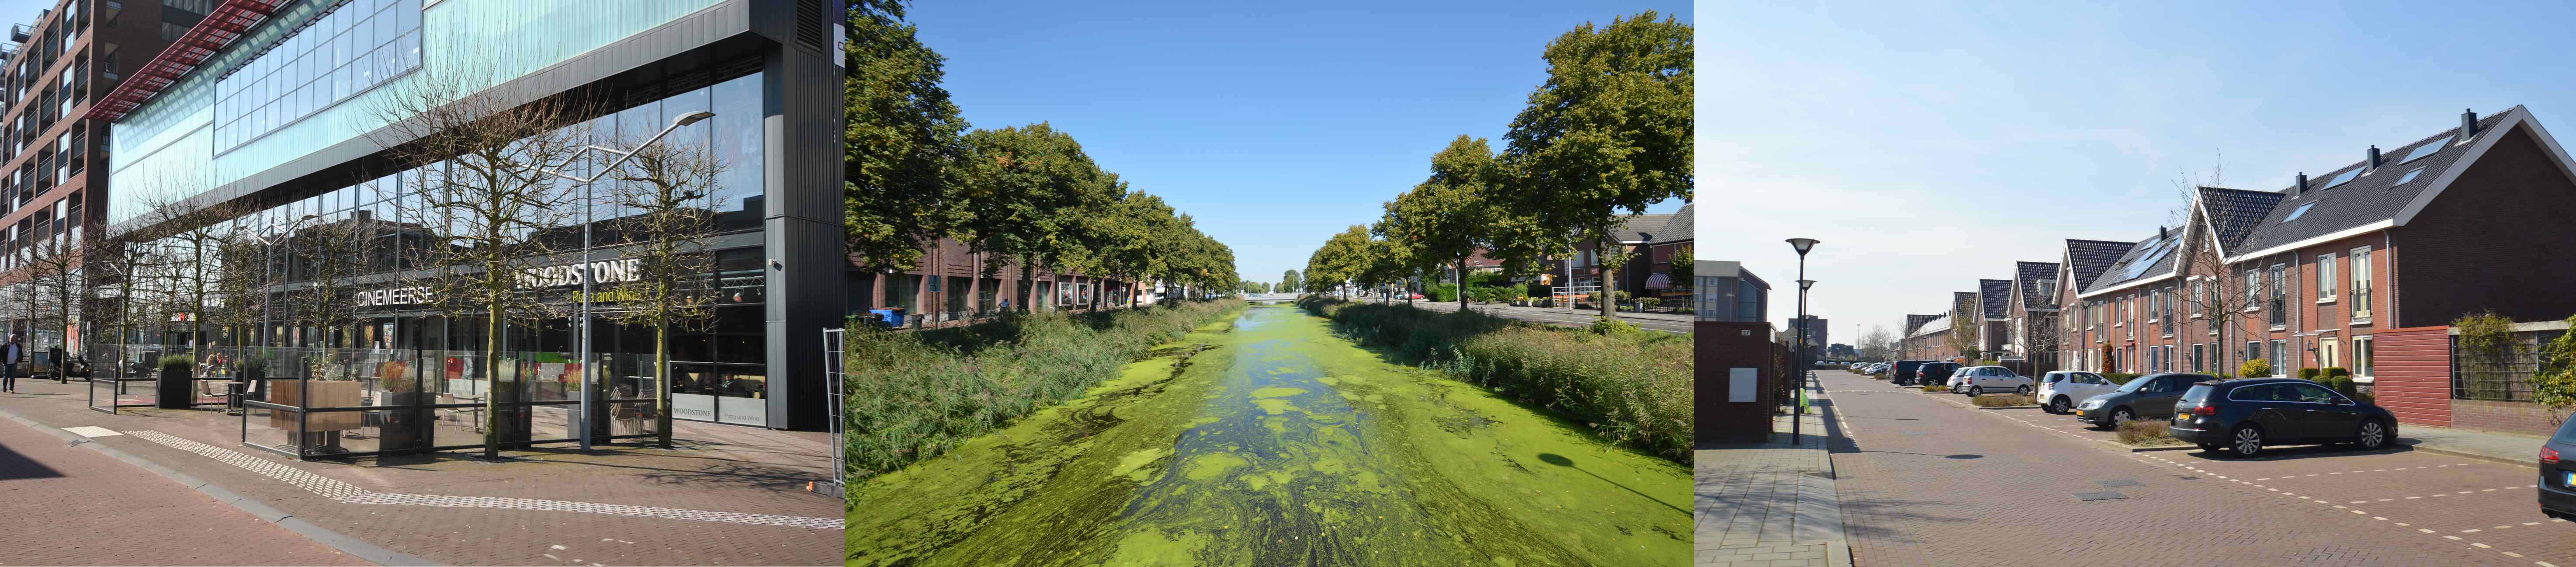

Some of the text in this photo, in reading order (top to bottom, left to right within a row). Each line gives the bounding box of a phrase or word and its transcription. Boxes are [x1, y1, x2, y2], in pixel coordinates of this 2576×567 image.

[573, 291, 594, 303] Piza
[597, 290, 614, 303] and
[674, 407, 711, 417] WOODSTONE
